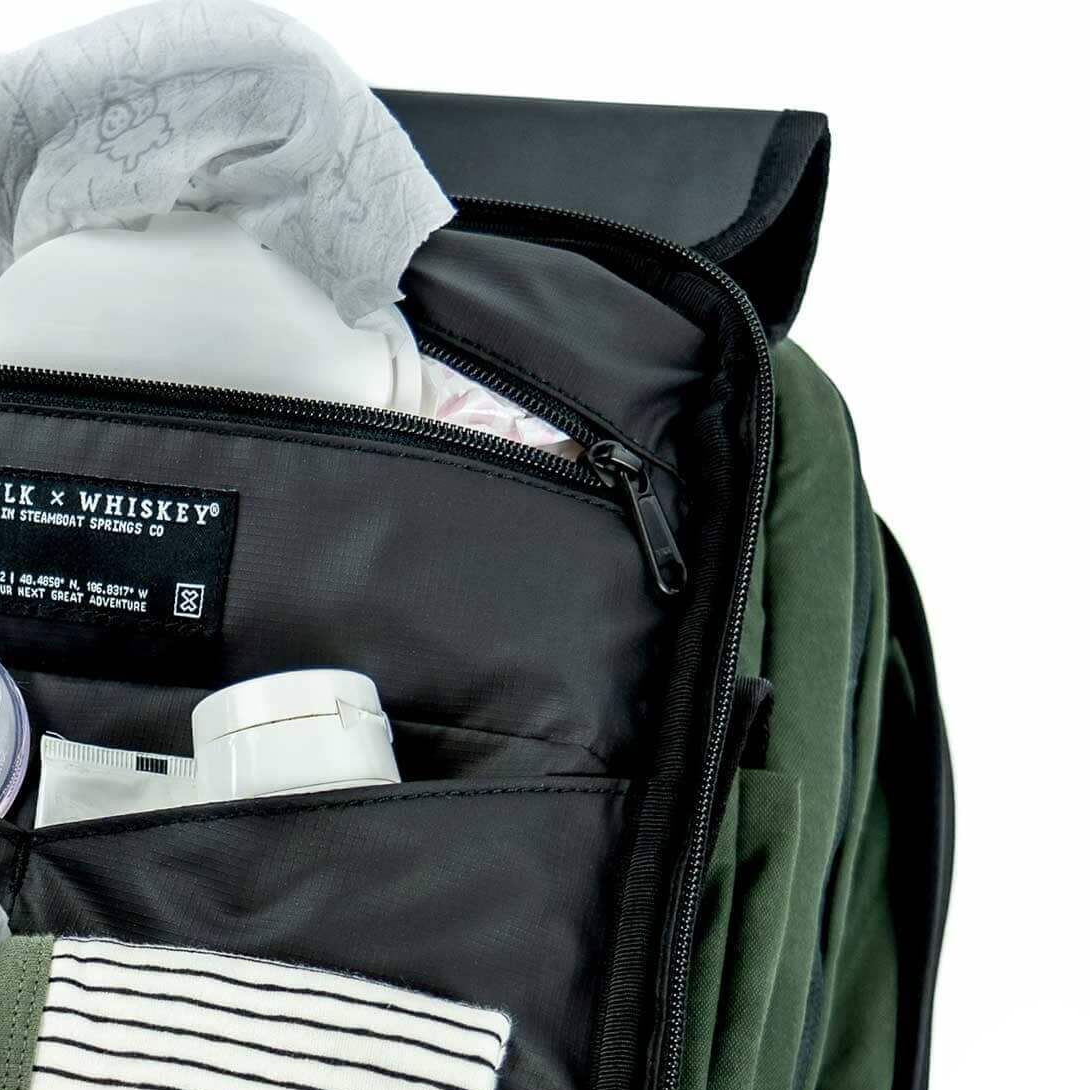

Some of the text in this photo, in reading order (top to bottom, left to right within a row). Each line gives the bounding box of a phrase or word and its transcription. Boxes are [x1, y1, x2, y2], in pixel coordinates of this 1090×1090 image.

[1, 507, 15, 520] IN
[20, 509, 85, 527] STEAMBOAT
[90, 516, 143, 535] SPRINGS
[149, 524, 164, 537] CO
[17, 586, 46, 599] NEXT
[51, 590, 84, 603] GREAT
[89, 594, 147, 612] ADVENTURE
[138, 588, 148, 599] W
